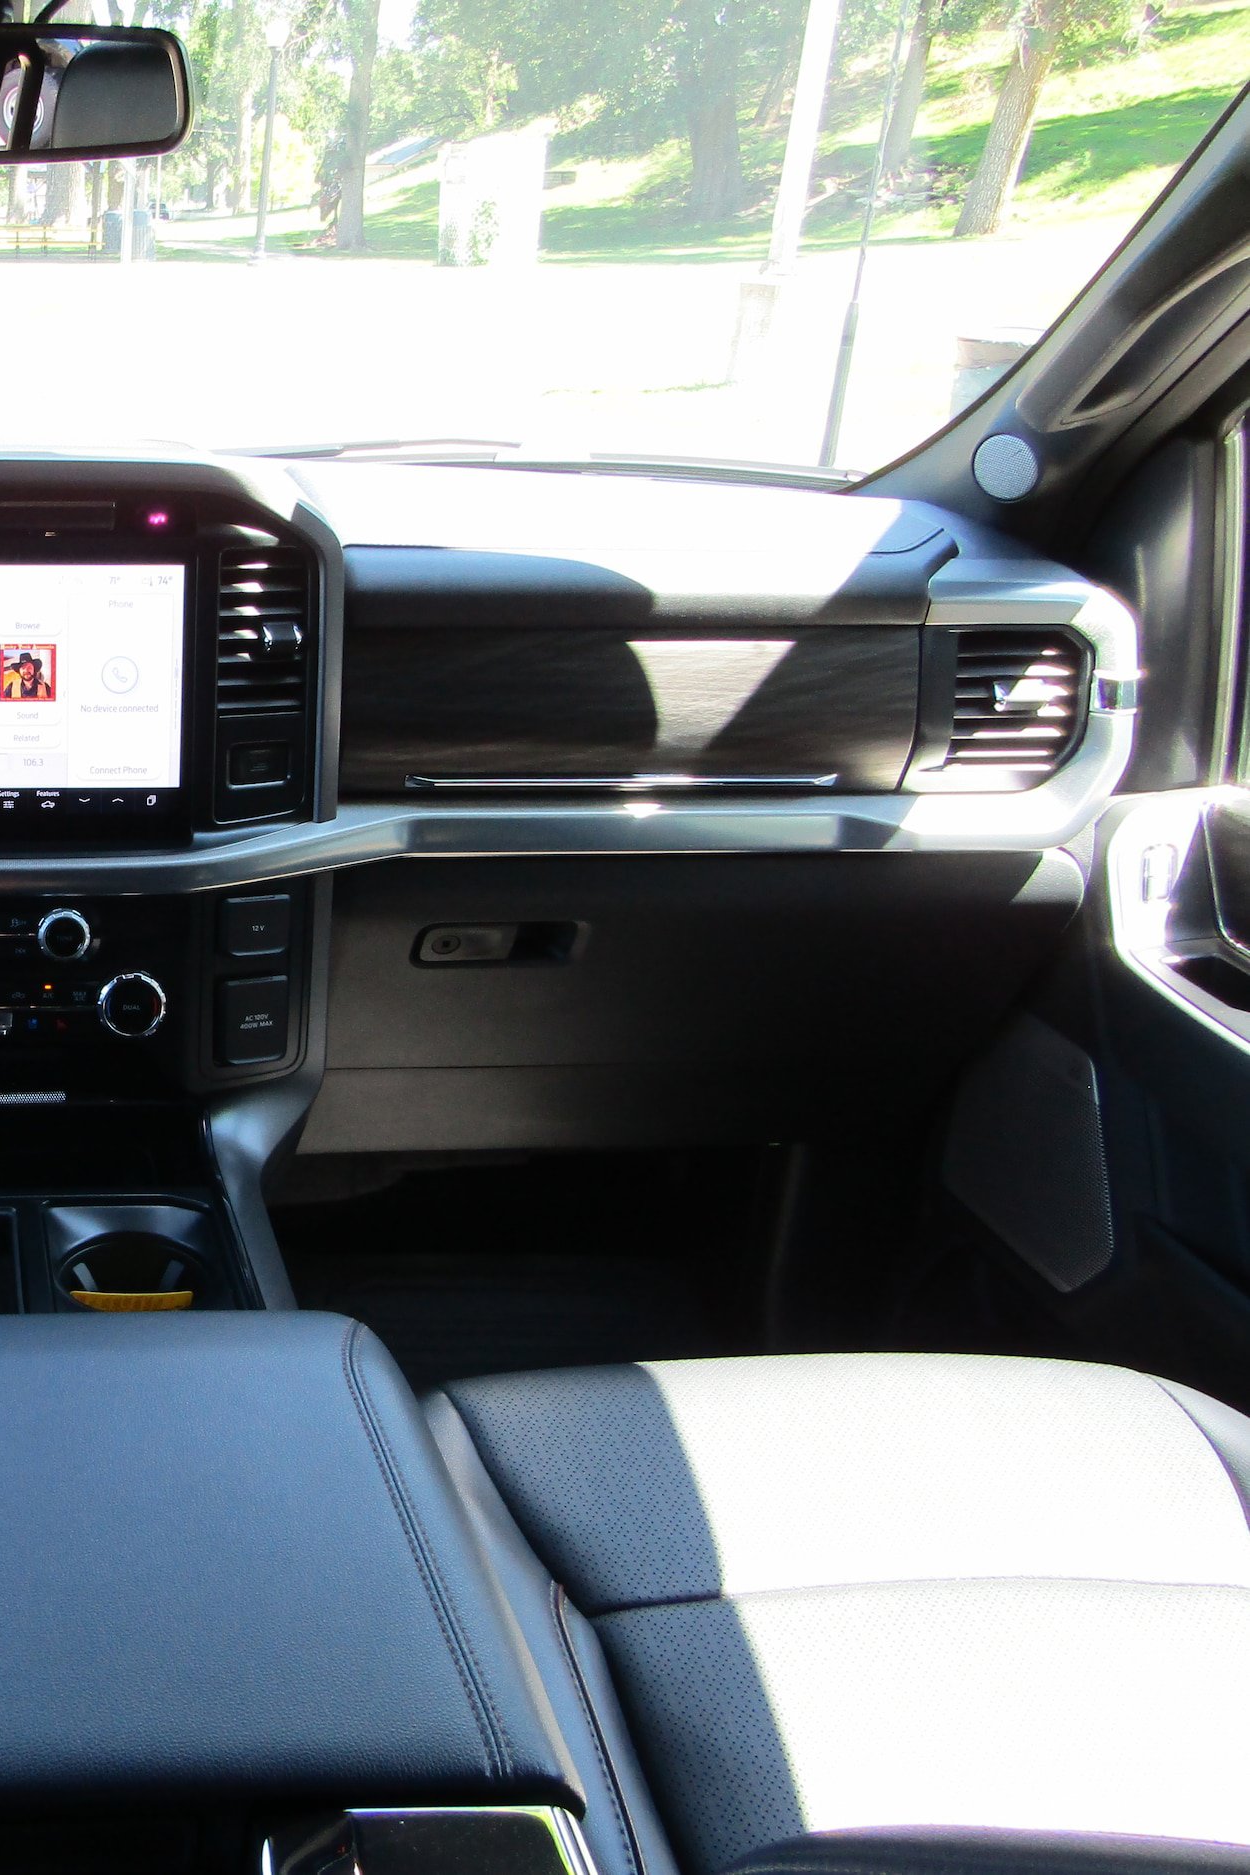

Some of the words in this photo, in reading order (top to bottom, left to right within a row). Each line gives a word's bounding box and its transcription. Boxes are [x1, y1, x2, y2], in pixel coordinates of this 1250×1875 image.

[158, 576, 173, 585] 74°
[108, 599, 134, 609] Phone
[15, 622, 41, 630] Browse
[80, 705, 92, 713] No
[93, 705, 118, 713] device
[118, 704, 159, 713] connected
[16, 712, 39, 720] Sound
[13, 734, 40, 743] Related
[23, 758, 44, 767] 106.3
[89, 766, 121, 776] Connect
[122, 766, 148, 775] Phone
[36, 790, 60, 798] Features
